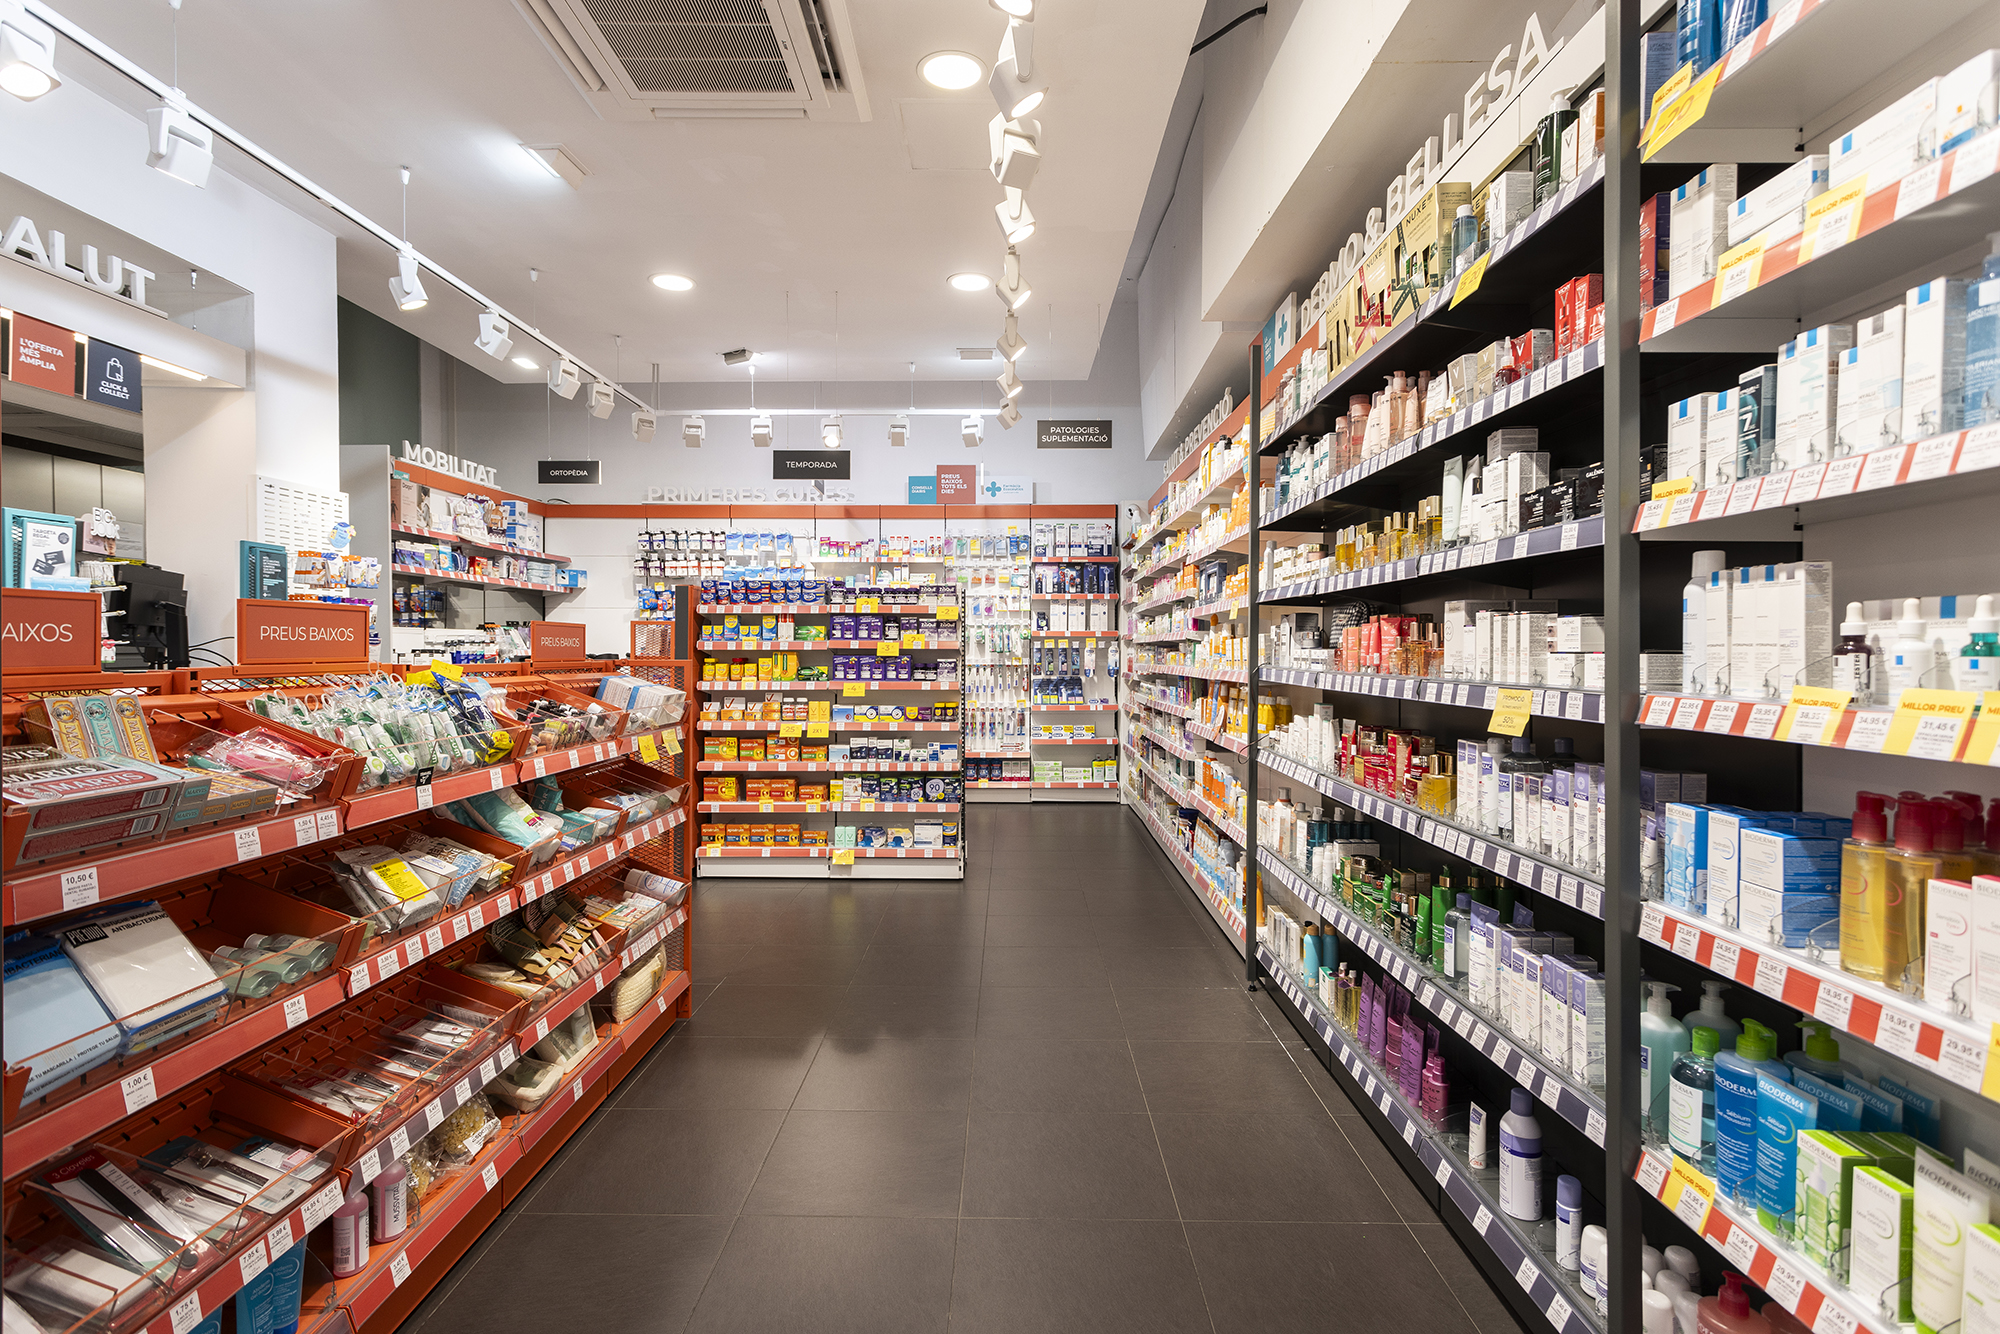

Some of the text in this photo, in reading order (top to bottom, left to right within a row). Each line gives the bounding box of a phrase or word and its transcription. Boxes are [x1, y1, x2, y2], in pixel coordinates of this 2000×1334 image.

[1673, 72, 1689, 91] PREU
[1301, 233, 1364, 333] DERMO
[1386, 12, 1558, 226] BELLESA
[1810, 188, 1861, 219] MILLOR PREU
[1406, 200, 1426, 227] NUXE
[0, 215, 155, 307] ALUT
[1720, 245, 1761, 271] MILLOR PREU
[20, 338, 64, 357] L'OFERTA
[20, 345, 40, 358] MÉS
[19, 354, 56, 371] ÀMPLIA
[99, 387, 130, 400] COLLECT
[101, 381, 122, 391] CLICK
[1041, 434, 1108, 443] SUPLEMENTACIÓ
[1050, 426, 1099, 434] PATOLOGIES
[403, 440, 497, 486] MOBILITAT
[786, 460, 838, 469] TEMPORADA
[550, 469, 588, 477] ORTOPÈDIA
[648, 485, 851, 503] PRIMERES CURES
[1655, 488, 1688, 499] MILLOR PREU
[2, 623, 73, 642] AIXOS
[260, 625, 354, 641] PREUS BAIXOS
[541, 637, 580, 647] PREUS BAIXOS
[1792, 697, 1841, 710] MILLOR PREU
[1902, 702, 1965, 713] MILLOR PREU
[1858, 716, 1880, 724] 34,95
[1922, 721, 1956, 732] 31,45 €
[3, 764, 97, 784] MARVIS
[49, 772, 146, 792] MARVIS
[187, 787, 207, 797] MARVIS
[176, 811, 198, 820] MARVIS
[1667, 808, 1692, 818] BIODERMA
[1711, 816, 1736, 827] BIODERMA
[239, 832, 251, 840] 4,75
[1745, 833, 1777, 845] BIODERMA
[66, 874, 86, 884] 10,50
[1744, 885, 1776, 899] BIODERMA
[1931, 885, 1968, 899] BIODERMA
[66, 925, 105, 945] PREMIUM
[1822, 986, 1842, 1001] 18,95
[1884, 1013, 1915, 1031] 18,95 €
[42, 1057, 73, 1076] MASCARILLA
[77, 1045, 98, 1058] PROTEGE
[106, 1033, 120, 1043] SALUD
[1946, 1039, 1982, 1060] 29,95 €
[127, 1077, 142, 1088] 1,00
[1714, 1074, 1757, 1097] BIODERM
[1758, 1080, 1804, 1111] BIODERMA
[1798, 1081, 1849, 1111] BIODERMA
[1845, 1083, 1889, 1113] BIODERMA
[1799, 1137, 1837, 1165] BIODERMA
[59, 1154, 95, 1175] Claveles
[1673, 1166, 1710, 1197] MILLOR PREU
[1856, 1174, 1895, 1202] BIODERMA
[1917, 1164, 1971, 1202] BIODERMA
[304, 1202, 316, 1213] 14,95
[175, 1297, 194, 1316] 1,75 €
